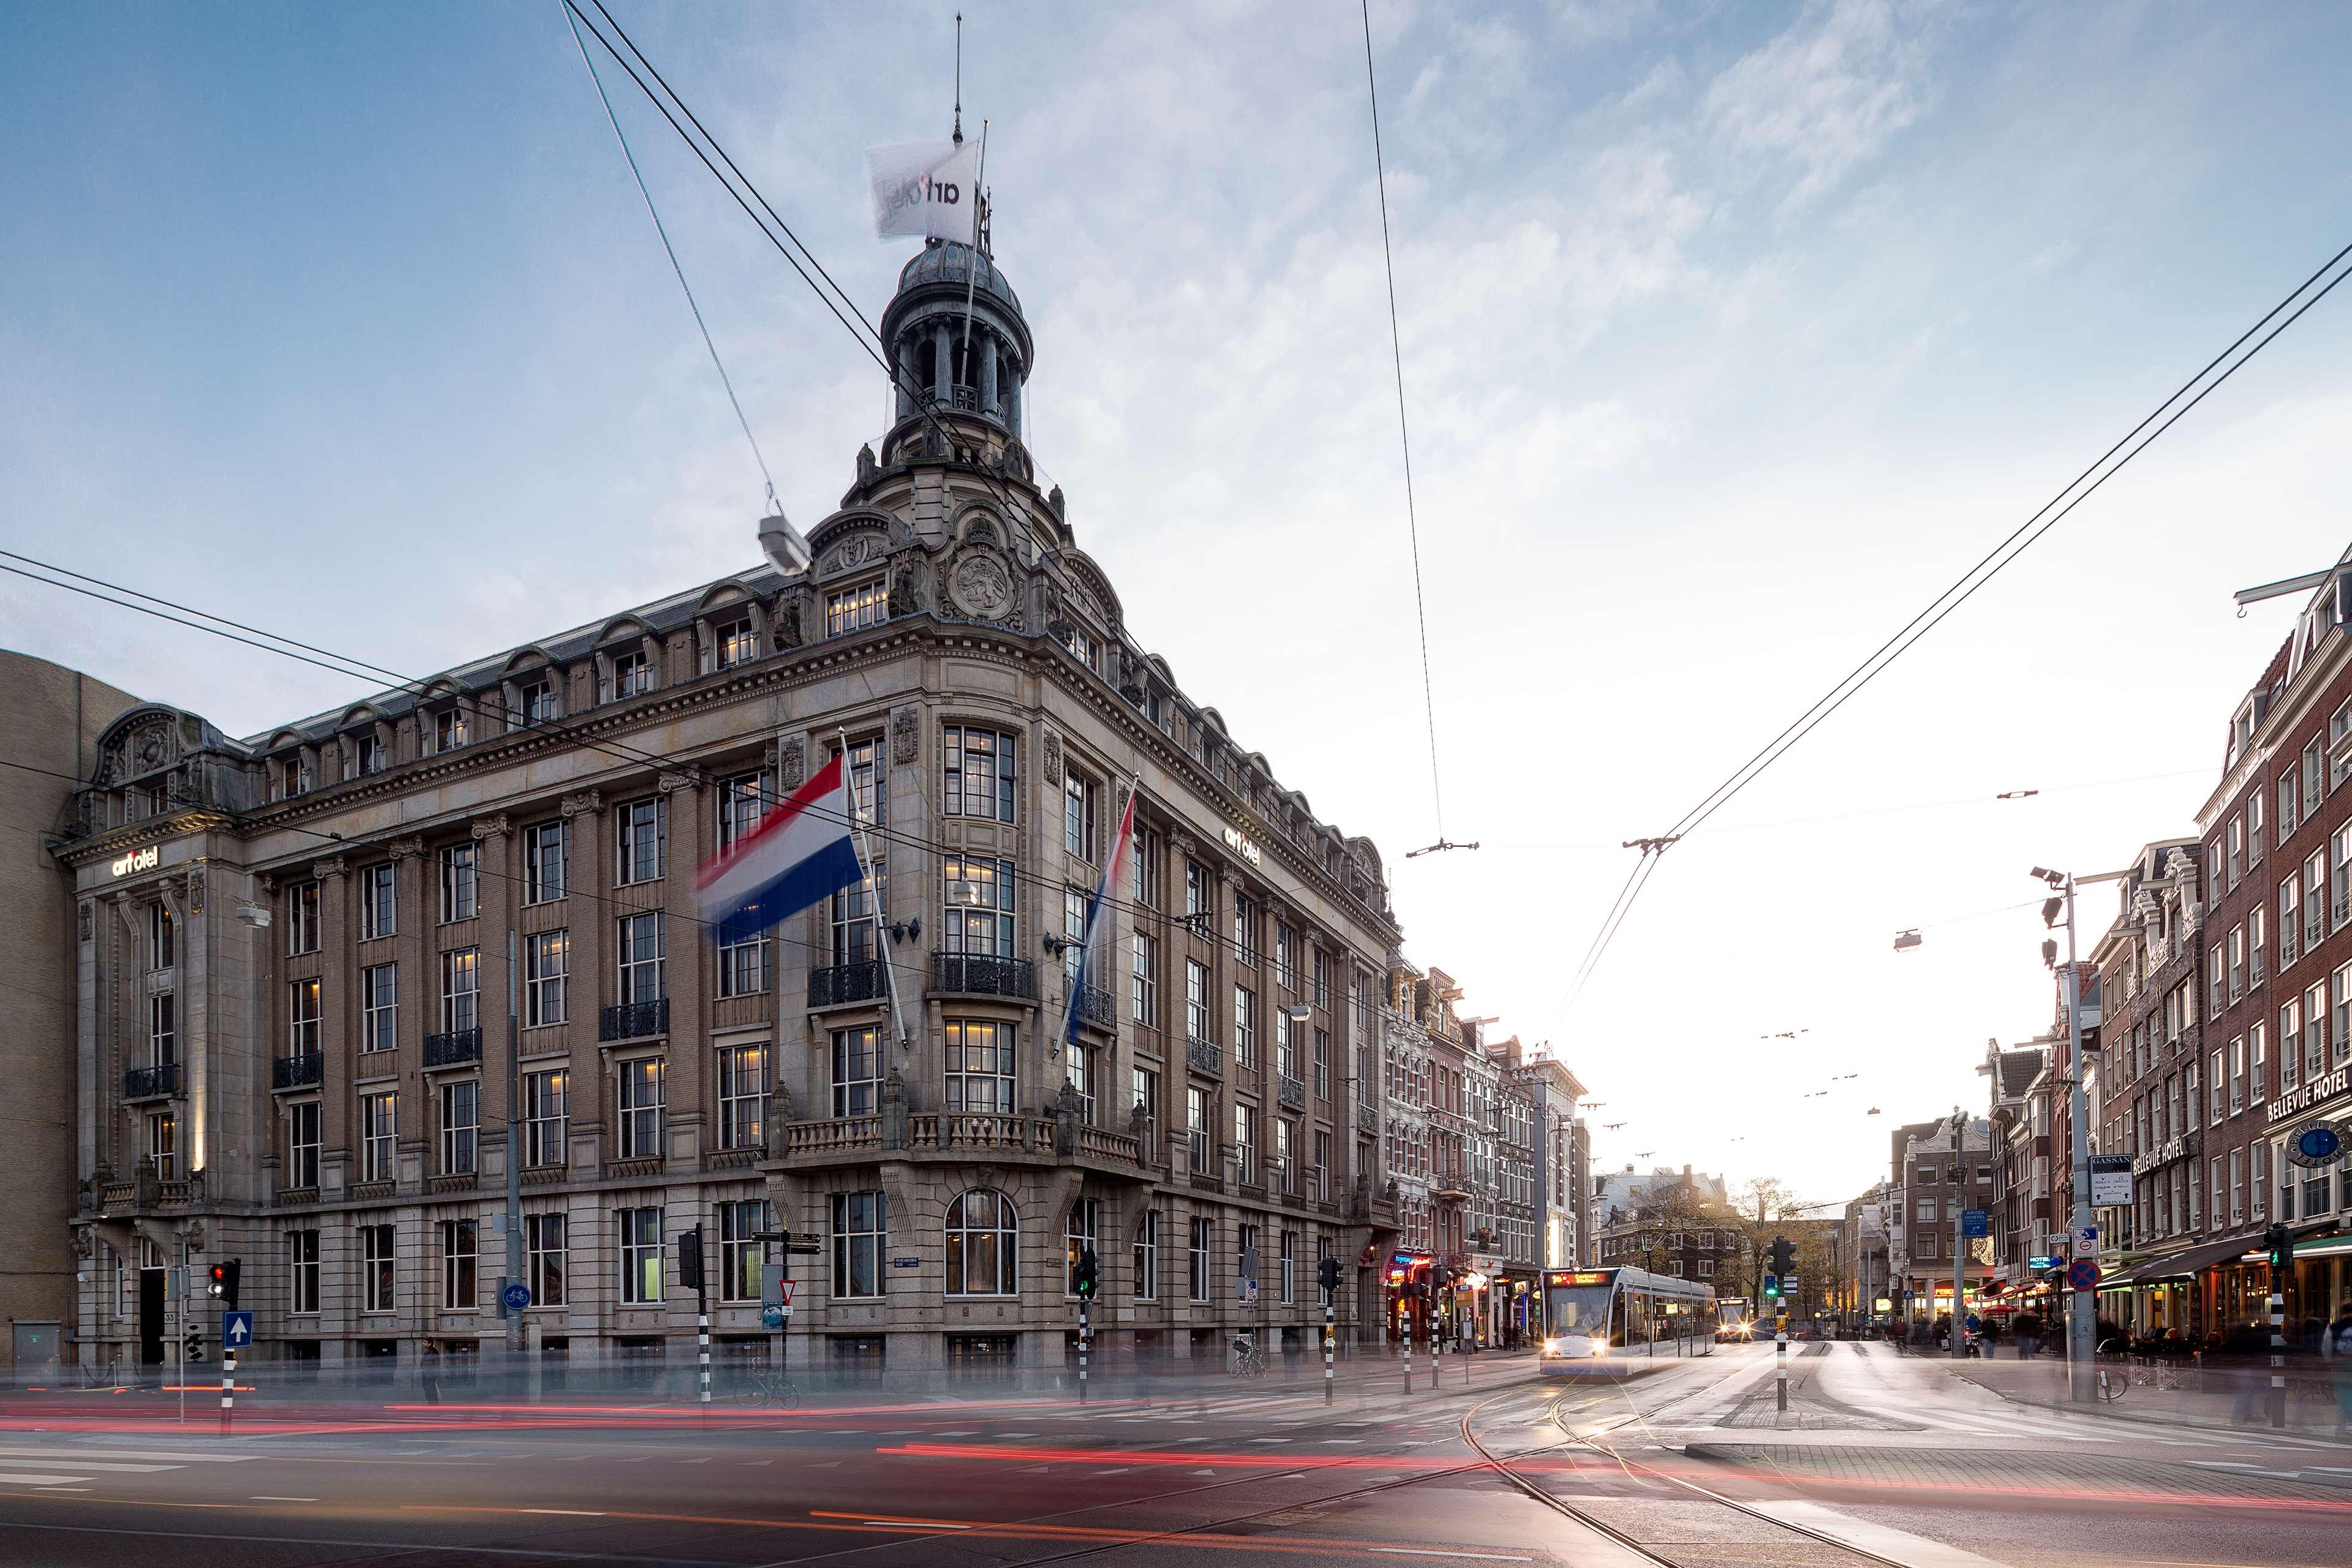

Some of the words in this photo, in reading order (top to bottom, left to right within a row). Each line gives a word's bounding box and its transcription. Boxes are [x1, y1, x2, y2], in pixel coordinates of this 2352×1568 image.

[2267, 1085, 2311, 1123] BELLEVUE
[2313, 1069, 2348, 1102] HOTEL
[2288, 1120, 2350, 1145] BELLEVUE
[2133, 1148, 2160, 1177] BELLEVUE
[2162, 1139, 2184, 1164] HOTEL
